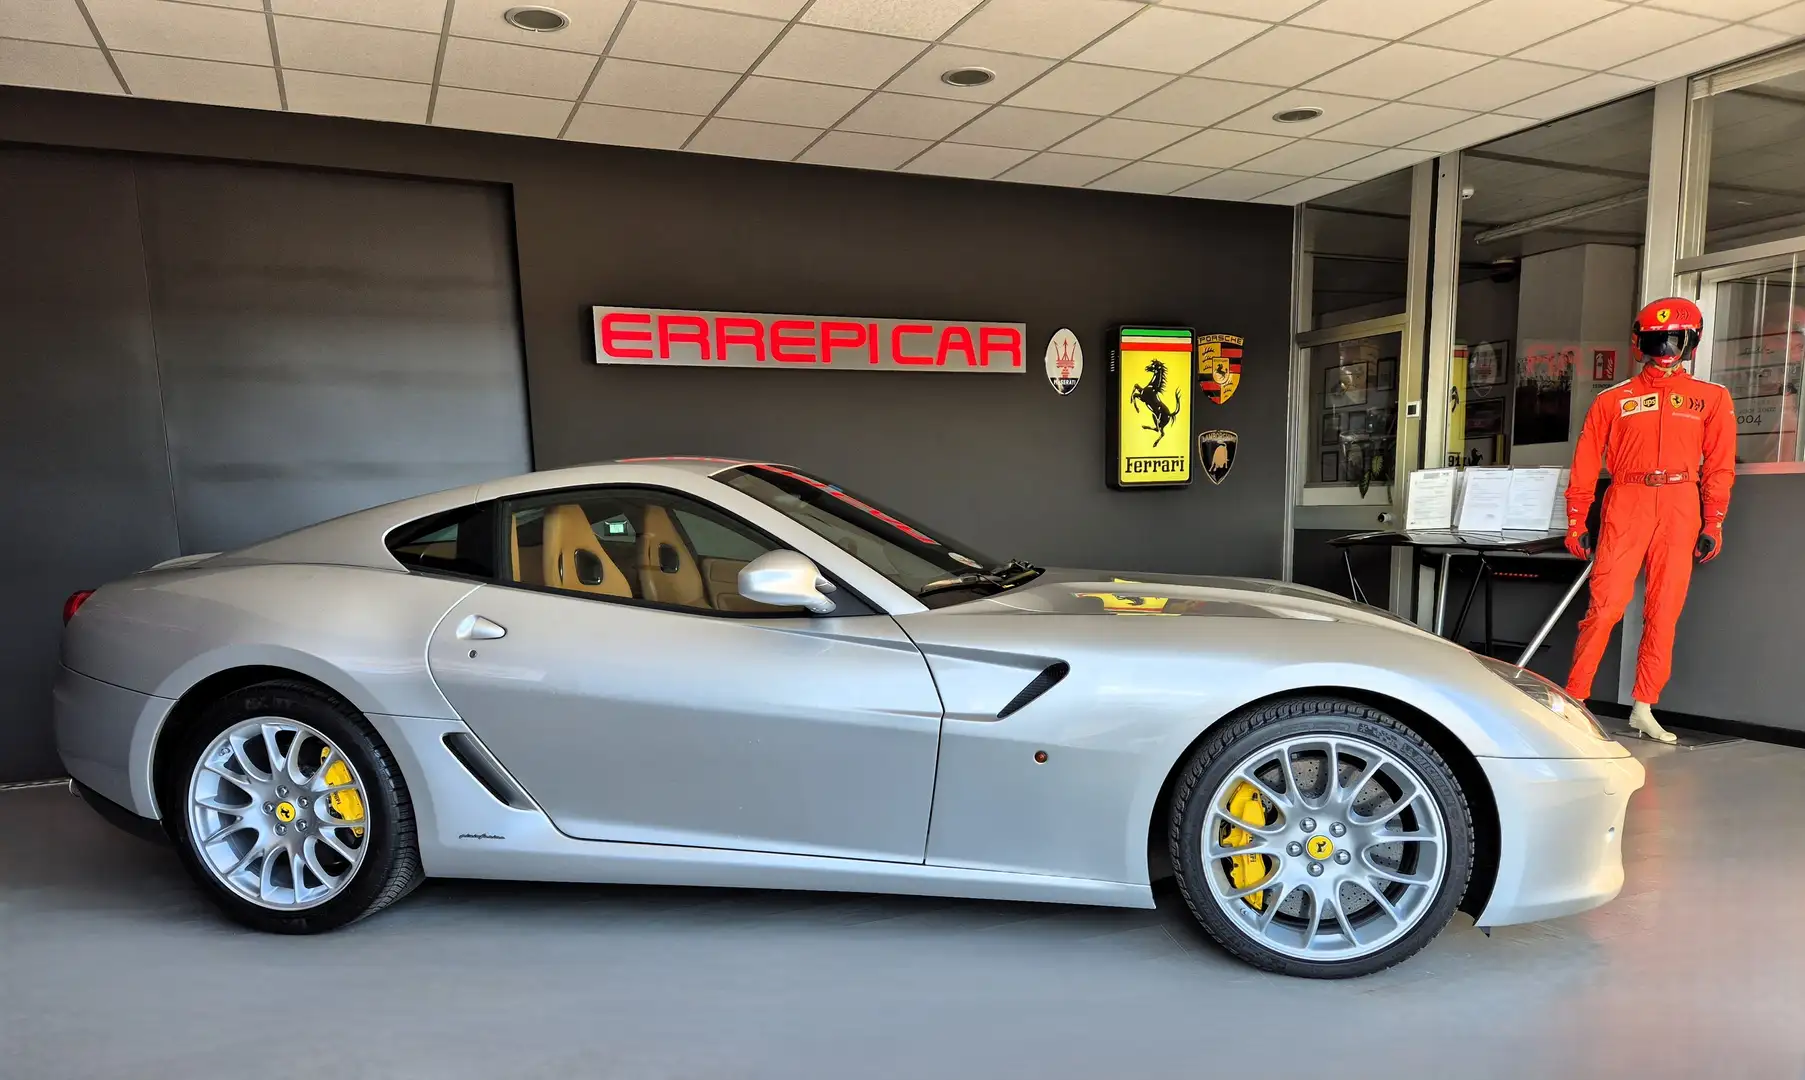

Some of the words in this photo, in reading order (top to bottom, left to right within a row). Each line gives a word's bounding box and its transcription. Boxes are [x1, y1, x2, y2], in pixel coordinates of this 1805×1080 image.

[601, 312, 879, 364] ERREPI
[892, 325, 1021, 367] CAR
[1199, 335, 1243, 345] PORSCHE
[1643, 398, 1656, 407] ups
[1125, 456, 1185, 474] Ferrari
